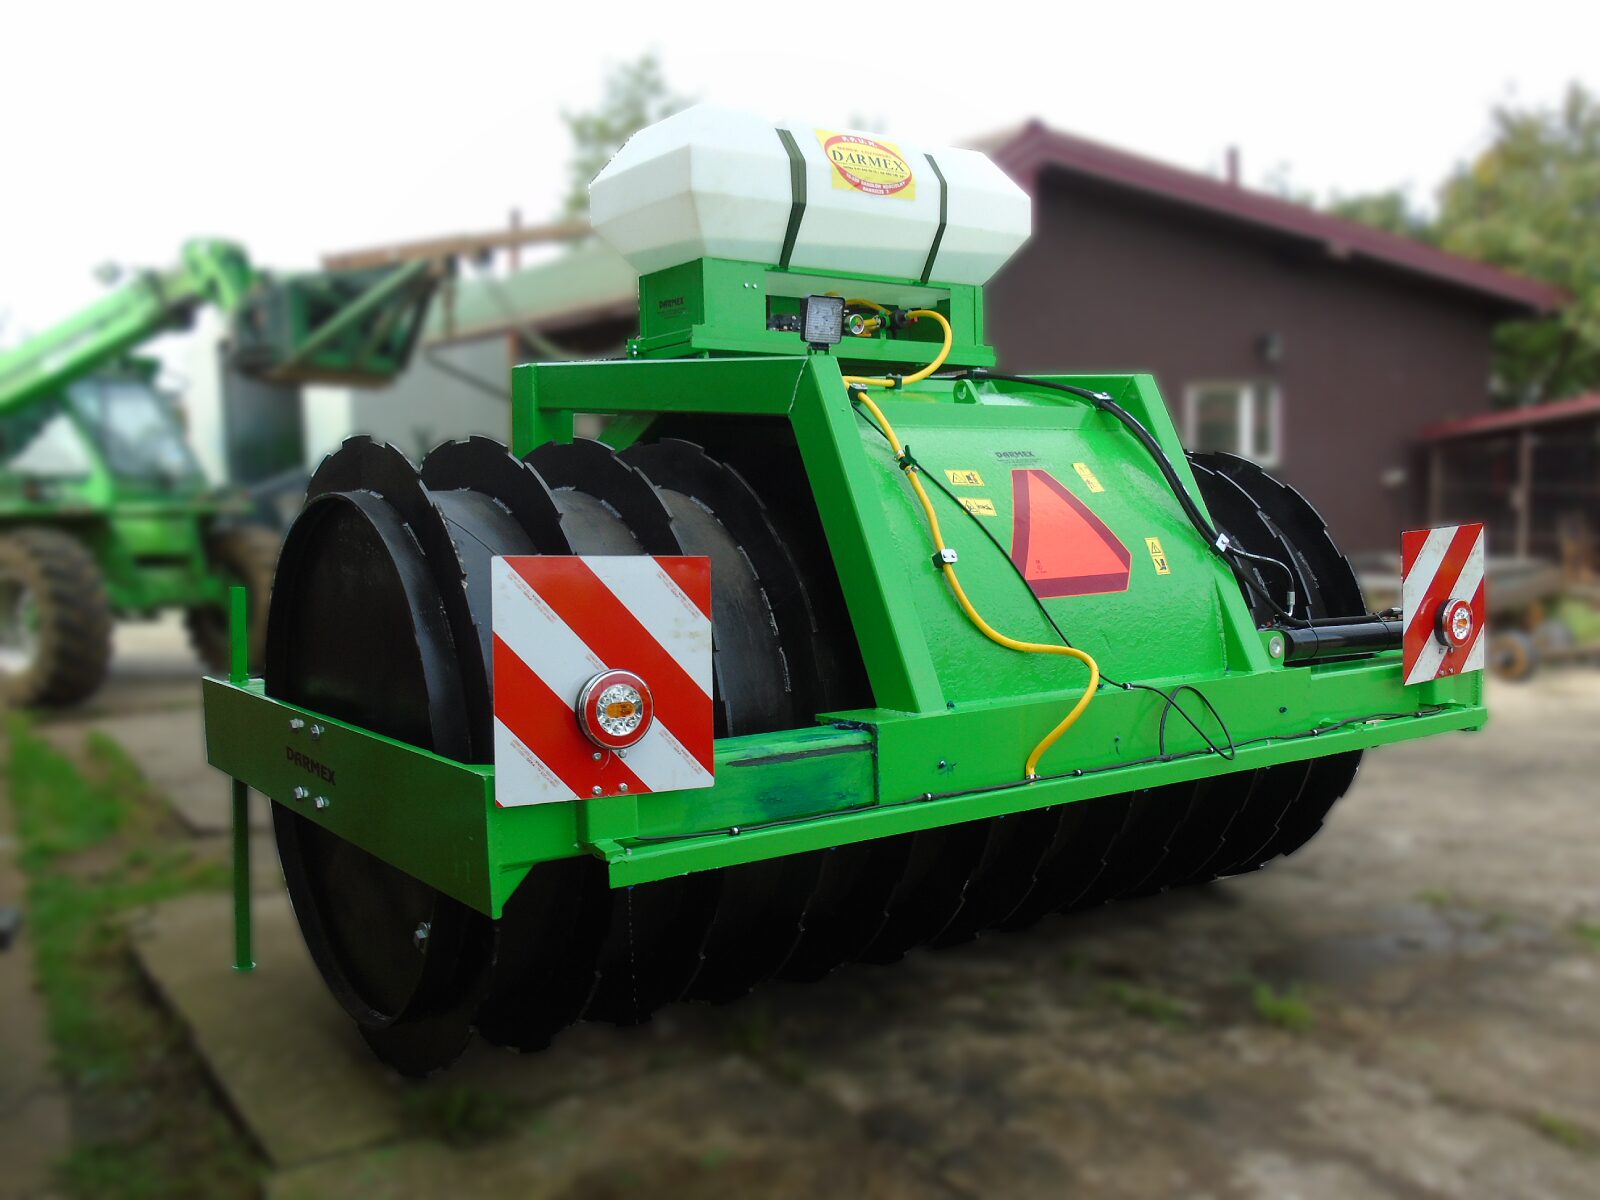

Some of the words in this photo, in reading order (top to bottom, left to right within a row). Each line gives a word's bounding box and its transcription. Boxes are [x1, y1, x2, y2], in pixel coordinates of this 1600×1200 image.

[832, 150, 905, 172] DARMEX
[995, 450, 1035, 459] DARMEX
[286, 746, 336, 786] DARMEX
